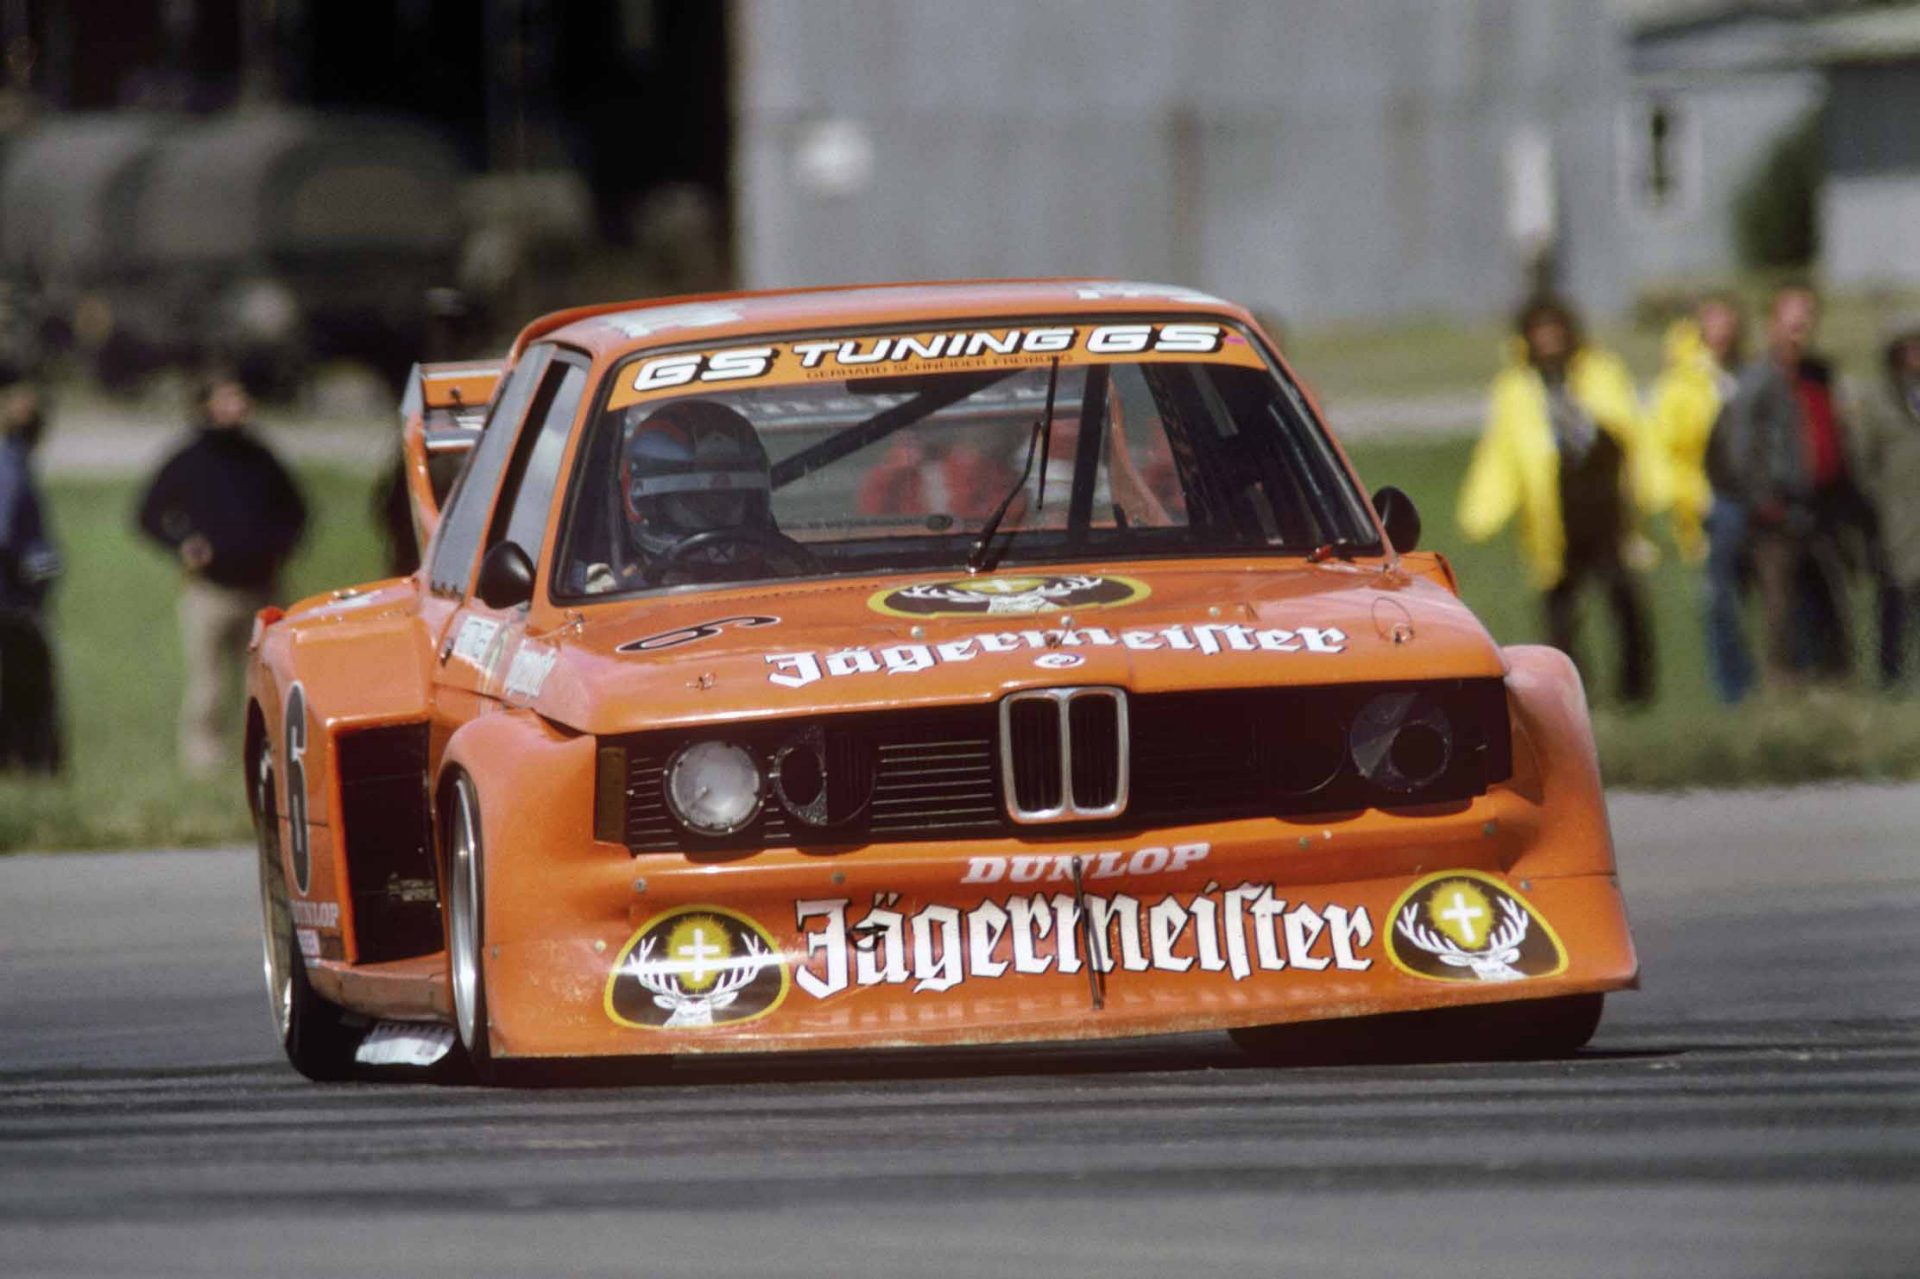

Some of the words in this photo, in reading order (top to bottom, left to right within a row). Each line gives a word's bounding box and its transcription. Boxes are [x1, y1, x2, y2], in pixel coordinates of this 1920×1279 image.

[633, 347, 774, 391] GS
[792, 326, 1077, 368] TUNING
[1086, 323, 1225, 353] GS
[614, 614, 782, 654] 6
[960, 842, 1212, 885] DUNLOP
